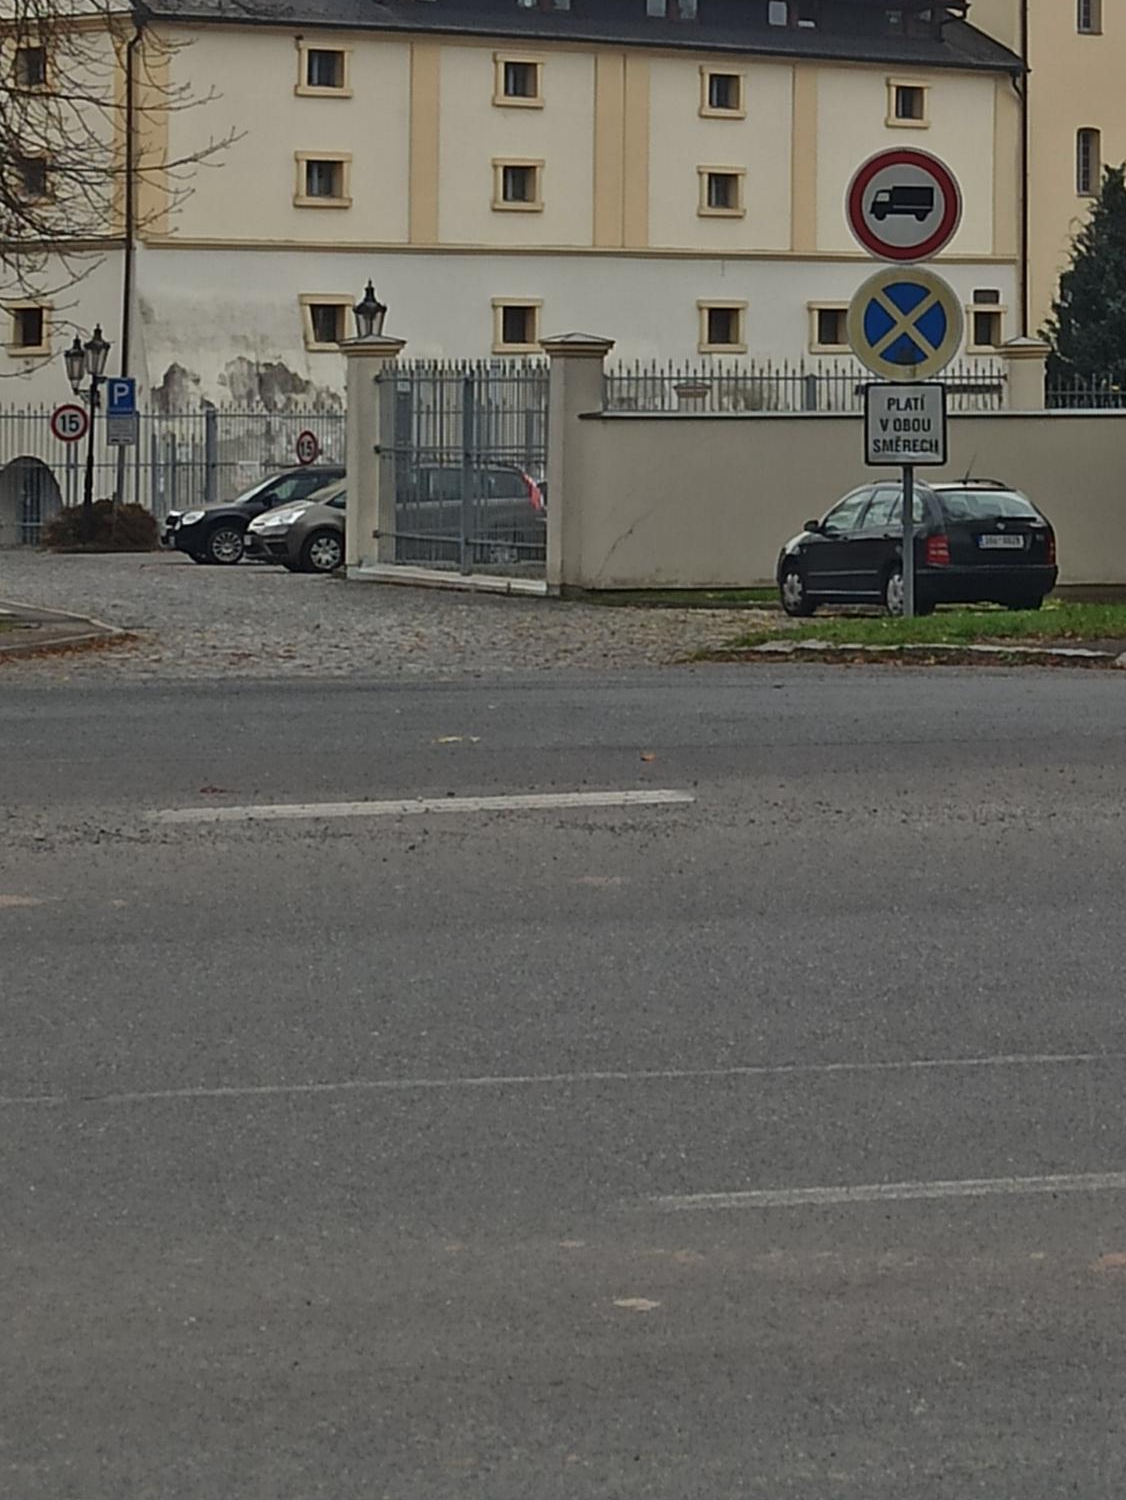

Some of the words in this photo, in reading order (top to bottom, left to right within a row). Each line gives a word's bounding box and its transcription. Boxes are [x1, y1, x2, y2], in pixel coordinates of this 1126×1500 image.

[114, 383, 129, 405] P
[887, 395, 925, 411] PLATÍ
[59, 415, 80, 432] 15
[880, 419, 889, 432] V
[893, 418, 931, 432] OBOU
[873, 435, 938, 453] SMĚRECH
